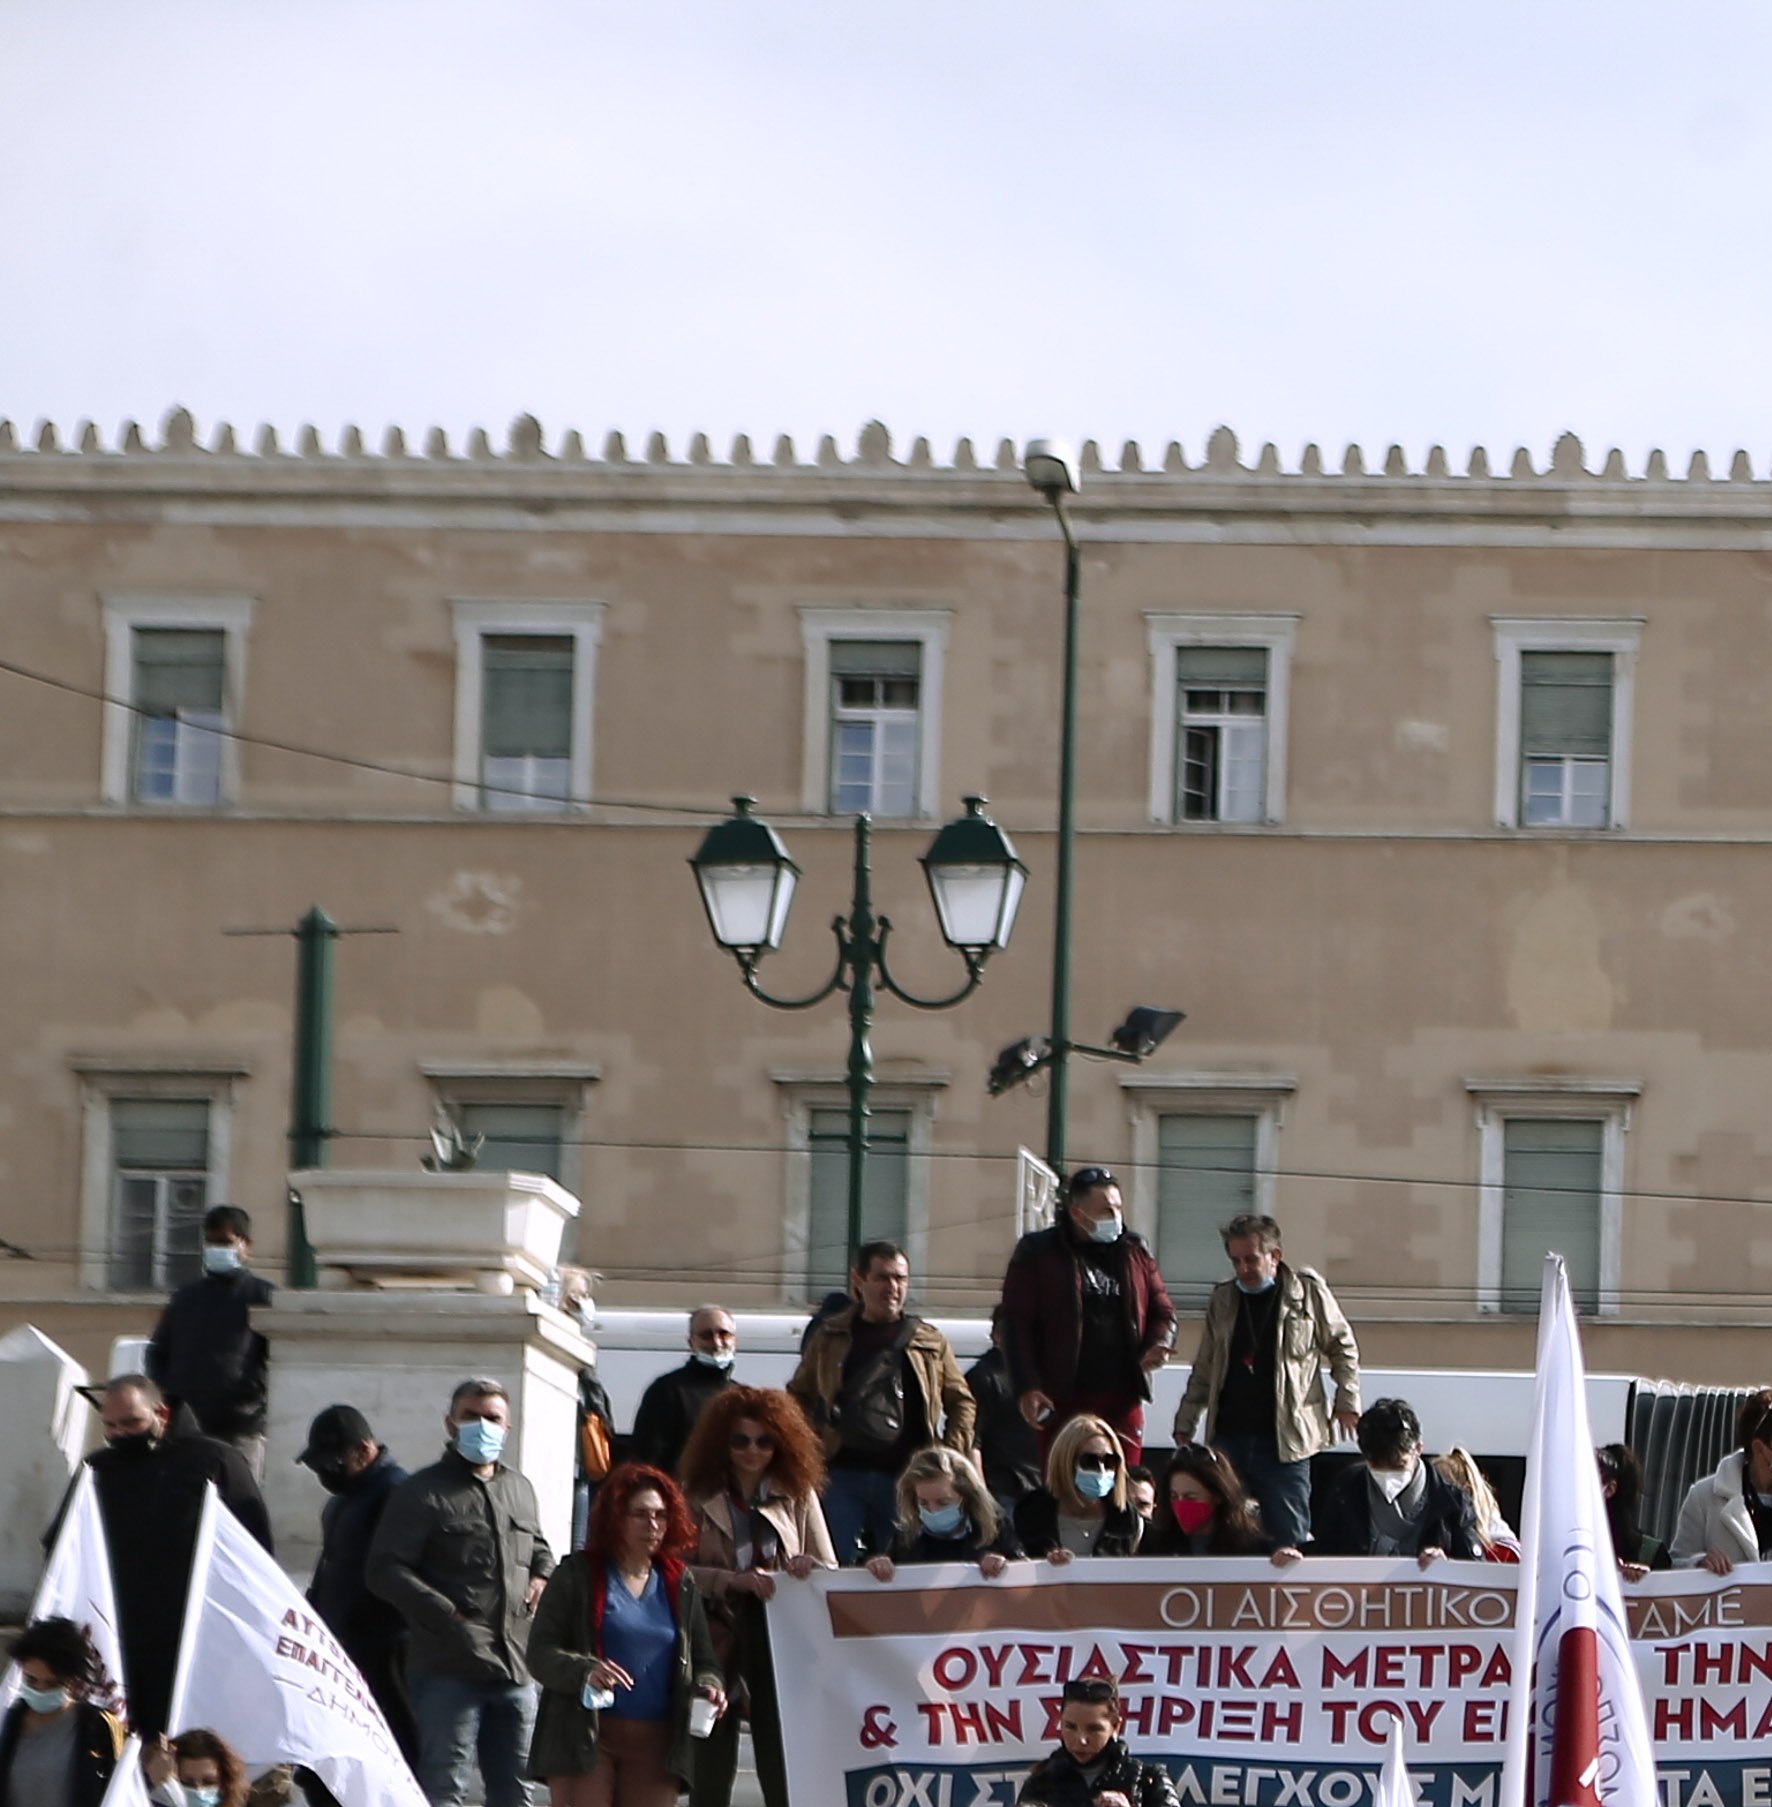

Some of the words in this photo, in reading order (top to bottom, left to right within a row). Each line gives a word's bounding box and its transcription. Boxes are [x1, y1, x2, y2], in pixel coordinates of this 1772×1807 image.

[1160, 1587, 1213, 1628] ΟΙ
[1231, 1587, 1511, 1628] ΑΙΣΘΗΤΙΚΟ
[933, 1641, 1302, 1691] ΟΥΣΙΑΣΤΙΚΑ
[1321, 1642, 1512, 1689] ΜΕΤΡΑ
[860, 1705, 899, 1749] &
[917, 1699, 1024, 1747] ΤΗΝ
[1038, 1696, 1303, 1743] ΣΗΡΙΞΗ
[1322, 1700, 1444, 1745] ΤΟΥ
